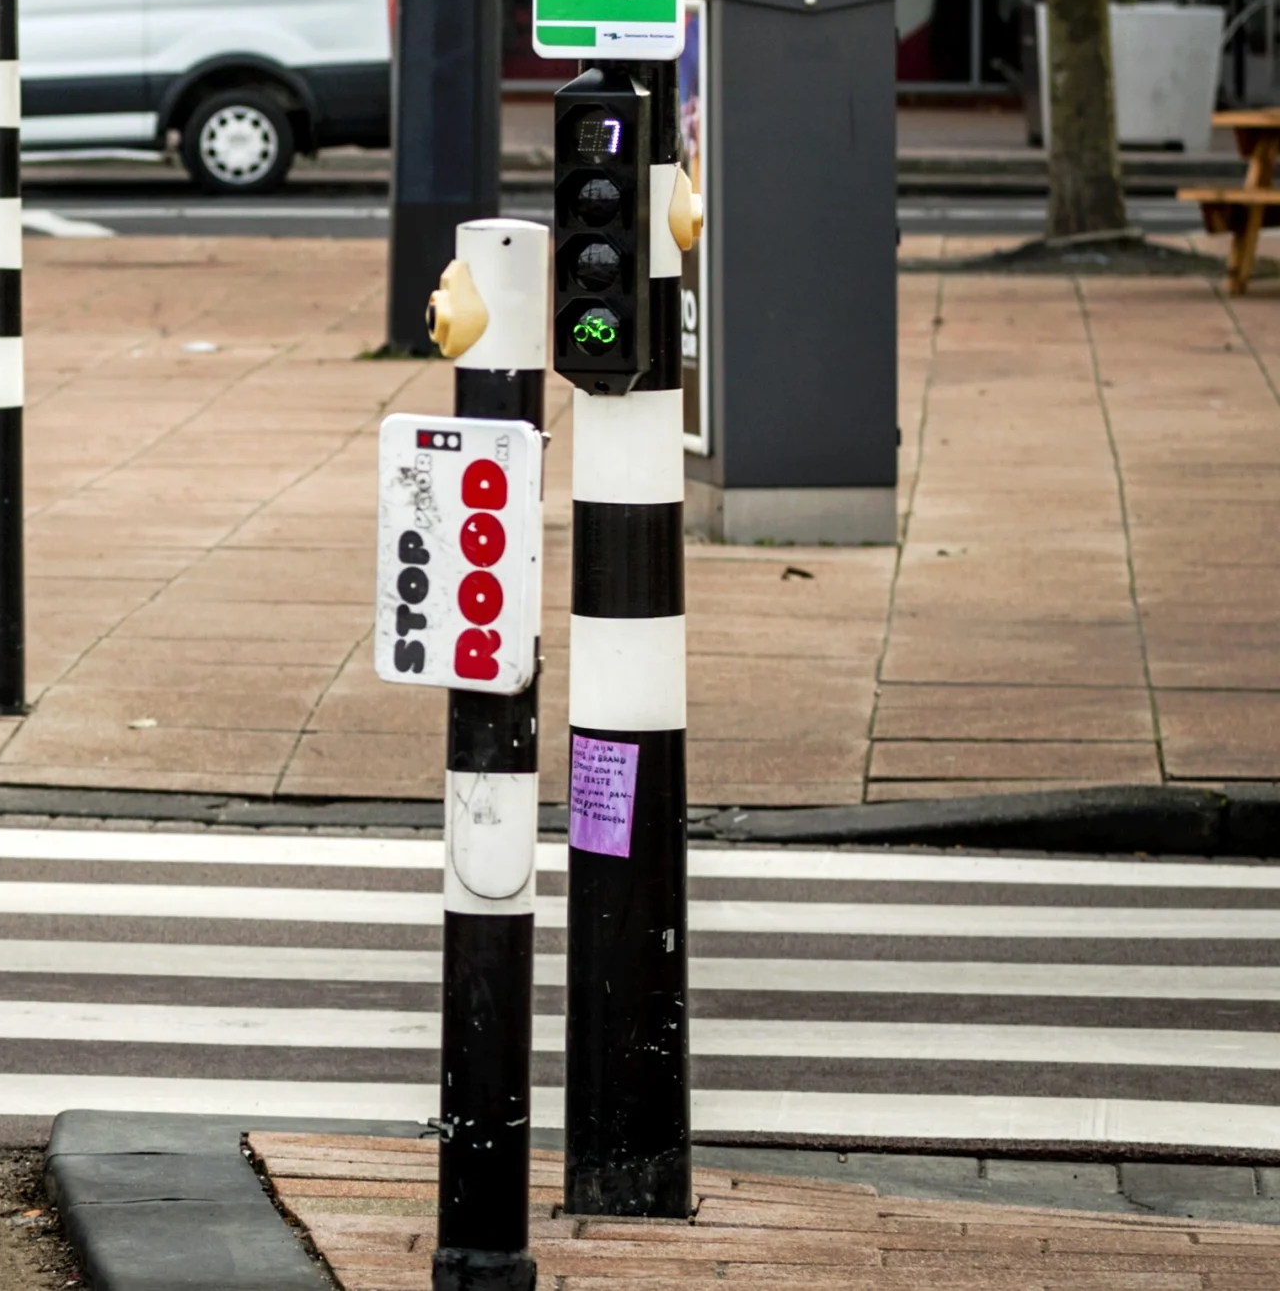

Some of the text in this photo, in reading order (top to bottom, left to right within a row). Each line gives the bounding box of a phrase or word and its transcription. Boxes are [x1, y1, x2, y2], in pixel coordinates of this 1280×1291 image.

[393, 530, 431, 674] STOP
[454, 458, 509, 681] ROOD
[598, 755, 626, 764] BRAND
